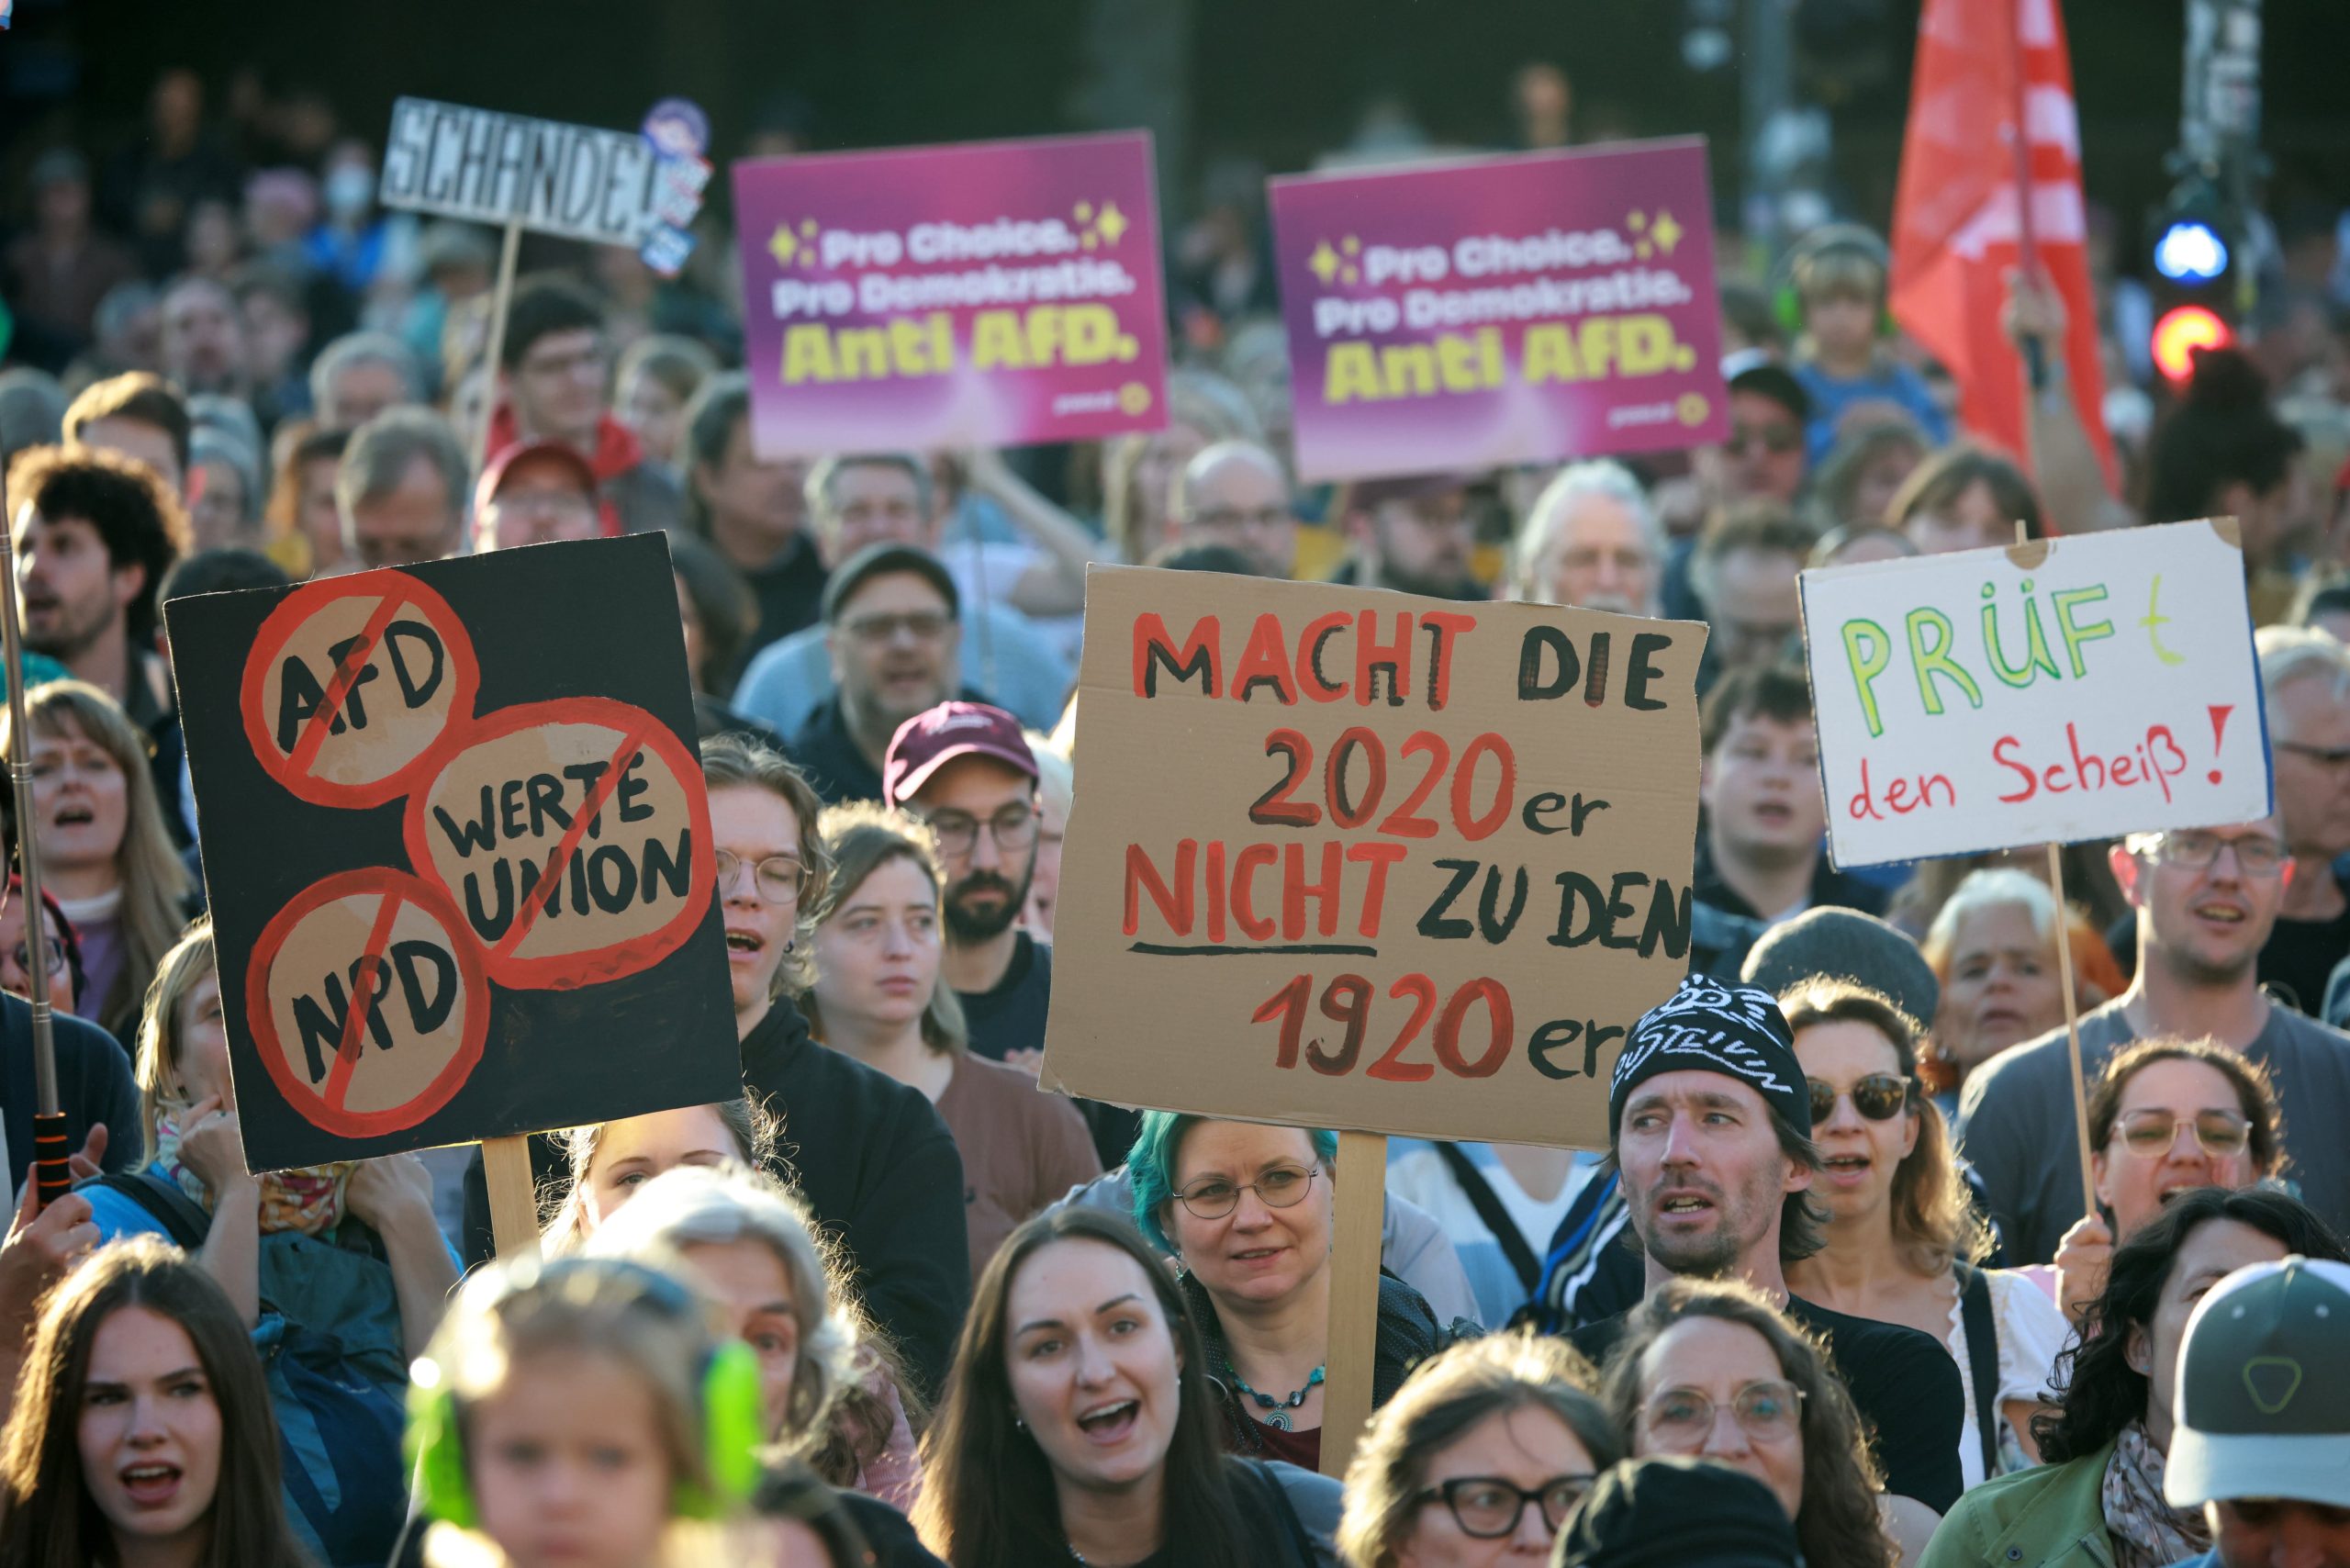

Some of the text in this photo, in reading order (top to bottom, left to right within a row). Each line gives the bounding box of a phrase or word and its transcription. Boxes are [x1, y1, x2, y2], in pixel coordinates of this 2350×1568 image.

[772, 257, 1136, 319] Pro Demokratie.
[822, 216, 1079, 269] Pro Choice.
[1364, 228, 1632, 286] Pro Choice.
[781, 303, 1139, 386] Anti AfD.
[1314, 268, 1692, 337] Pro Demokratie.
[1326, 313, 1696, 404] Anti AfD.
[277, 620, 444, 754] AFD
[1133, 610, 1673, 711] MACHT DIE
[432, 752, 655, 858] WERTE
[1849, 704, 2234, 820] den Scheiß!
[464, 828, 692, 942] UNION
[1123, 838, 1692, 959] NICHT ZU DEN
[293, 939, 457, 1083] NPD
